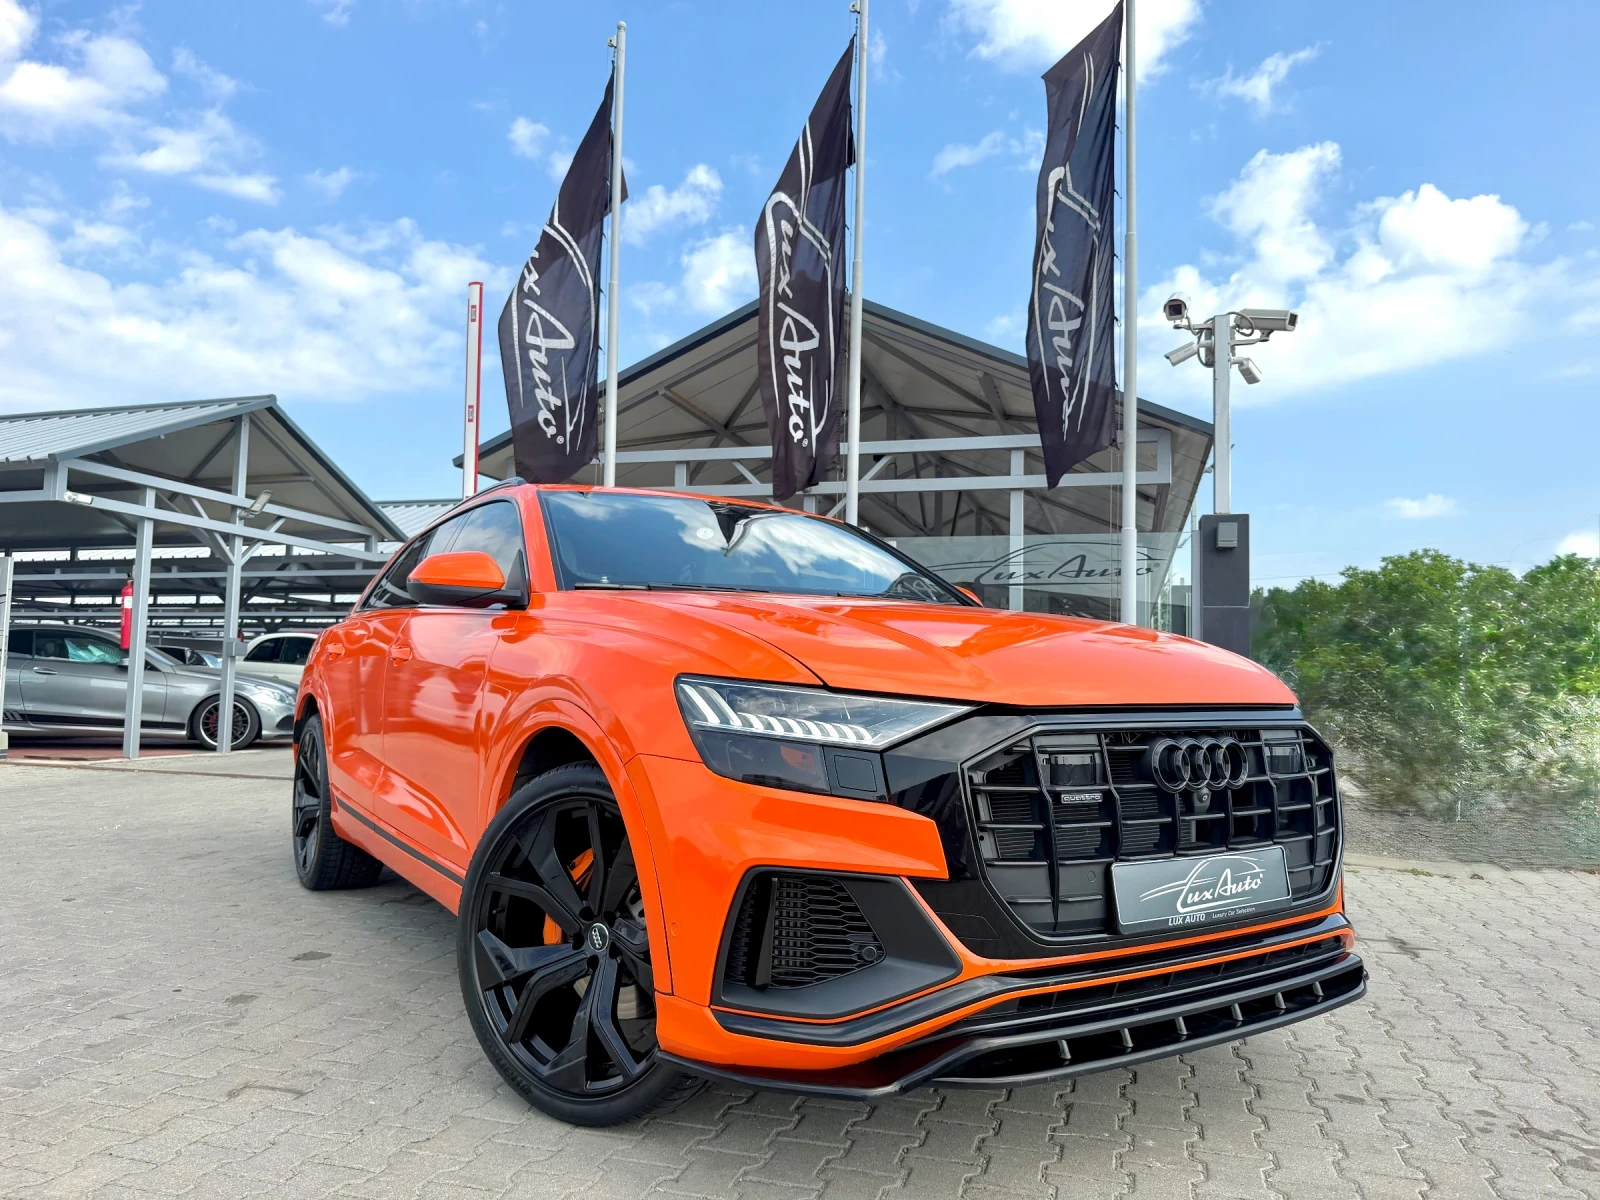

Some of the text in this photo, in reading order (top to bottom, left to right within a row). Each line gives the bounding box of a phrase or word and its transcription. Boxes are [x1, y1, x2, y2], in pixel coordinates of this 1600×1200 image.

[1063, 794, 1101, 803] quattro
[1168, 915, 1183, 926] LUX
[1184, 913, 1206, 924] AUTO
